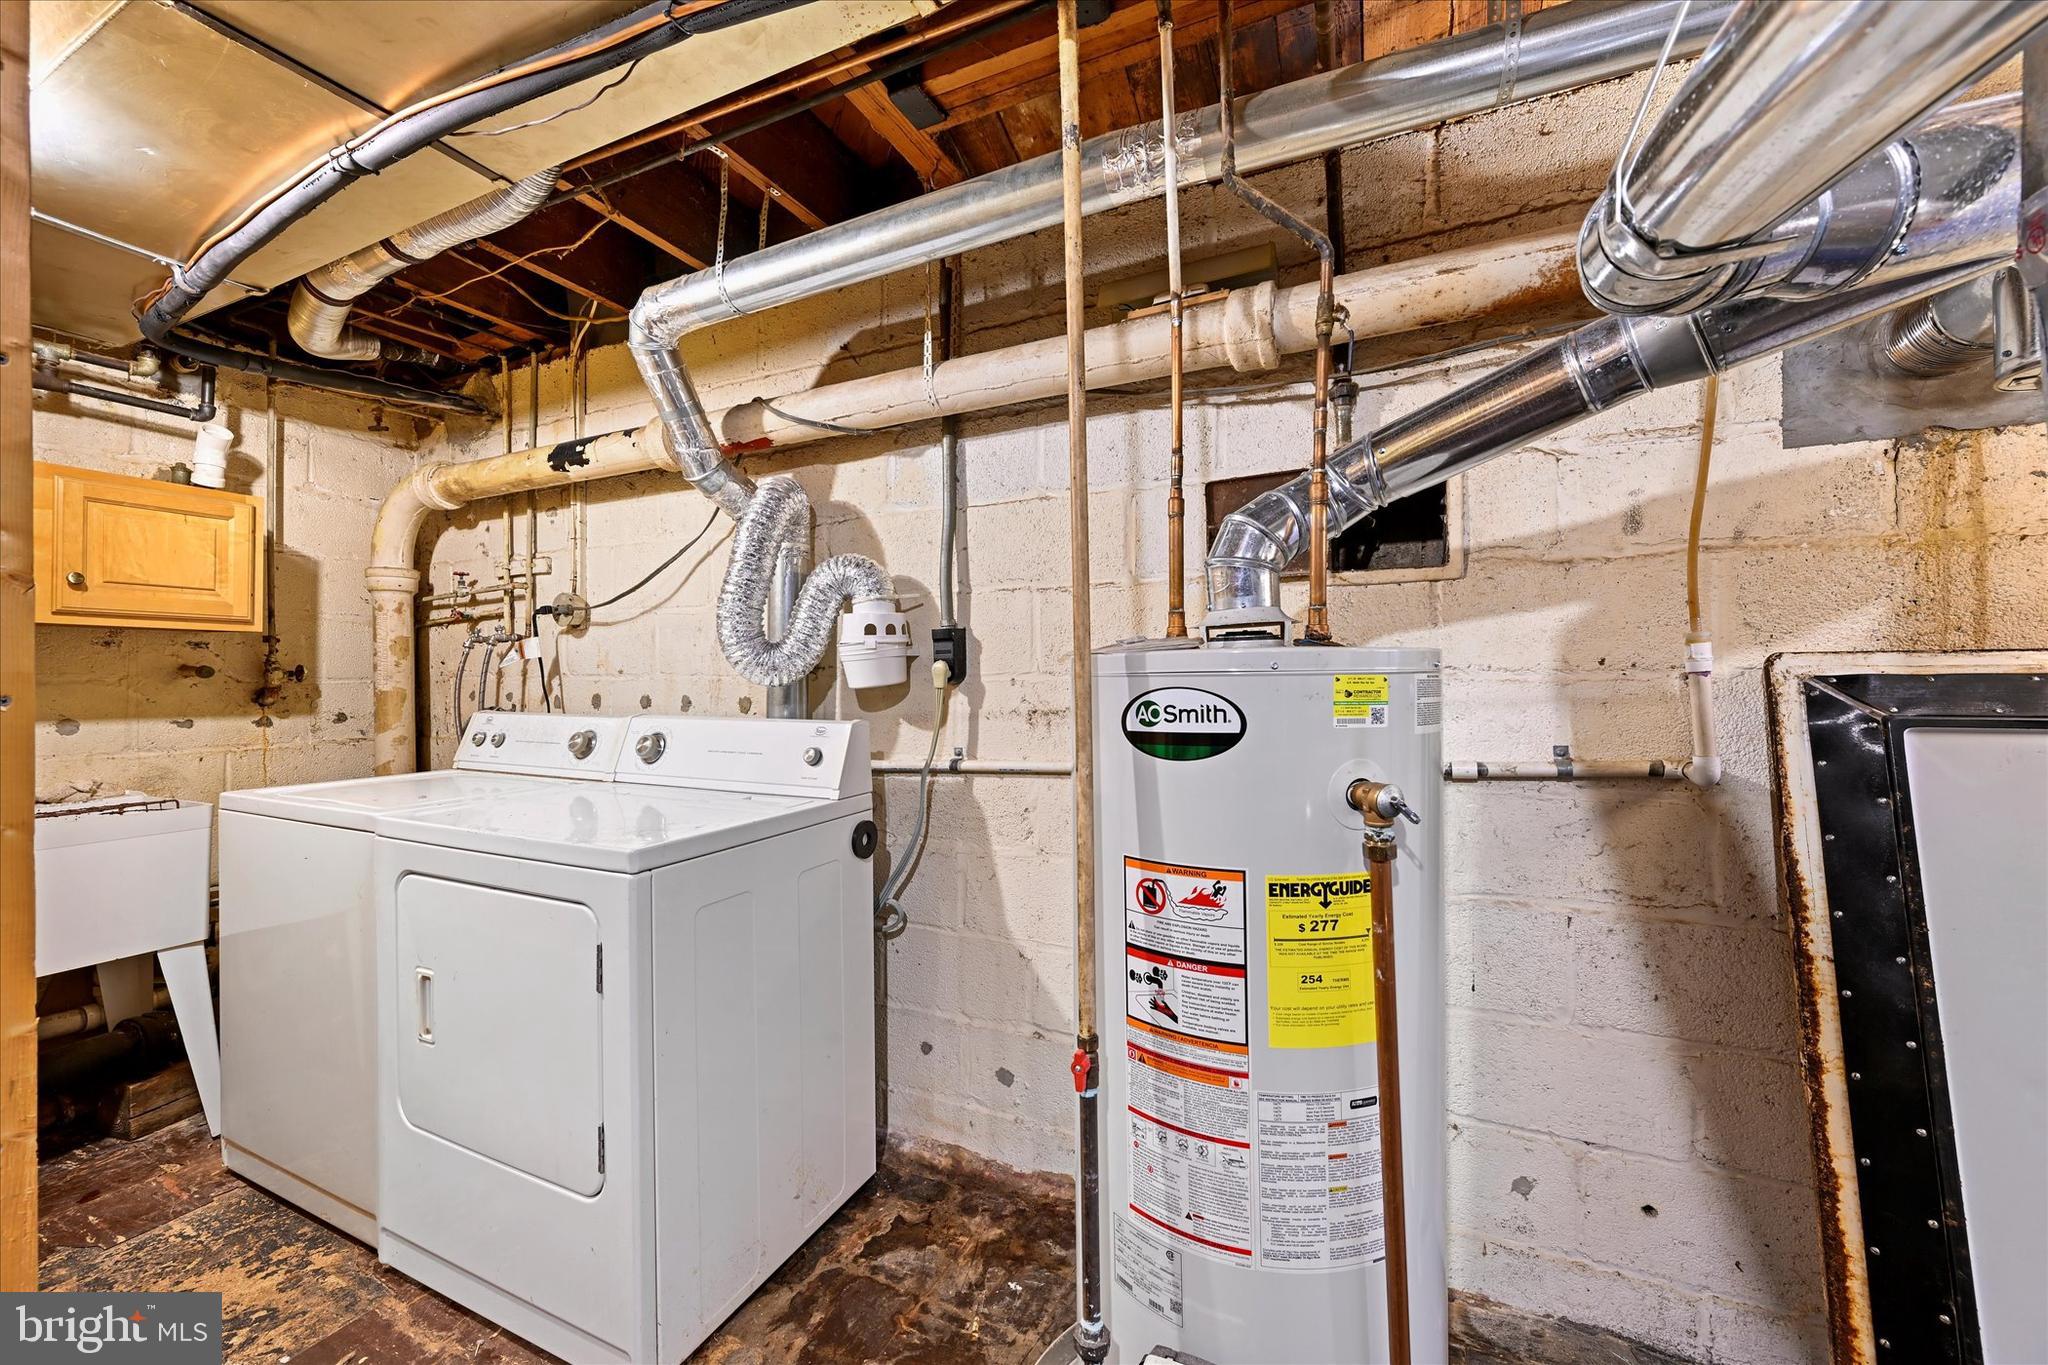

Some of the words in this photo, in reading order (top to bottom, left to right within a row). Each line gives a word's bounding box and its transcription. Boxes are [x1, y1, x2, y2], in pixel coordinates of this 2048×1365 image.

[1164, 704, 1228, 723] Smith
[1172, 868, 1207, 878] WARNING
[1268, 878, 1372, 898] ENERGYGUIDE
[1310, 920, 1339, 932] 277
[1176, 962, 1208, 972] DANGER
[1301, 975, 1323, 984] 254
